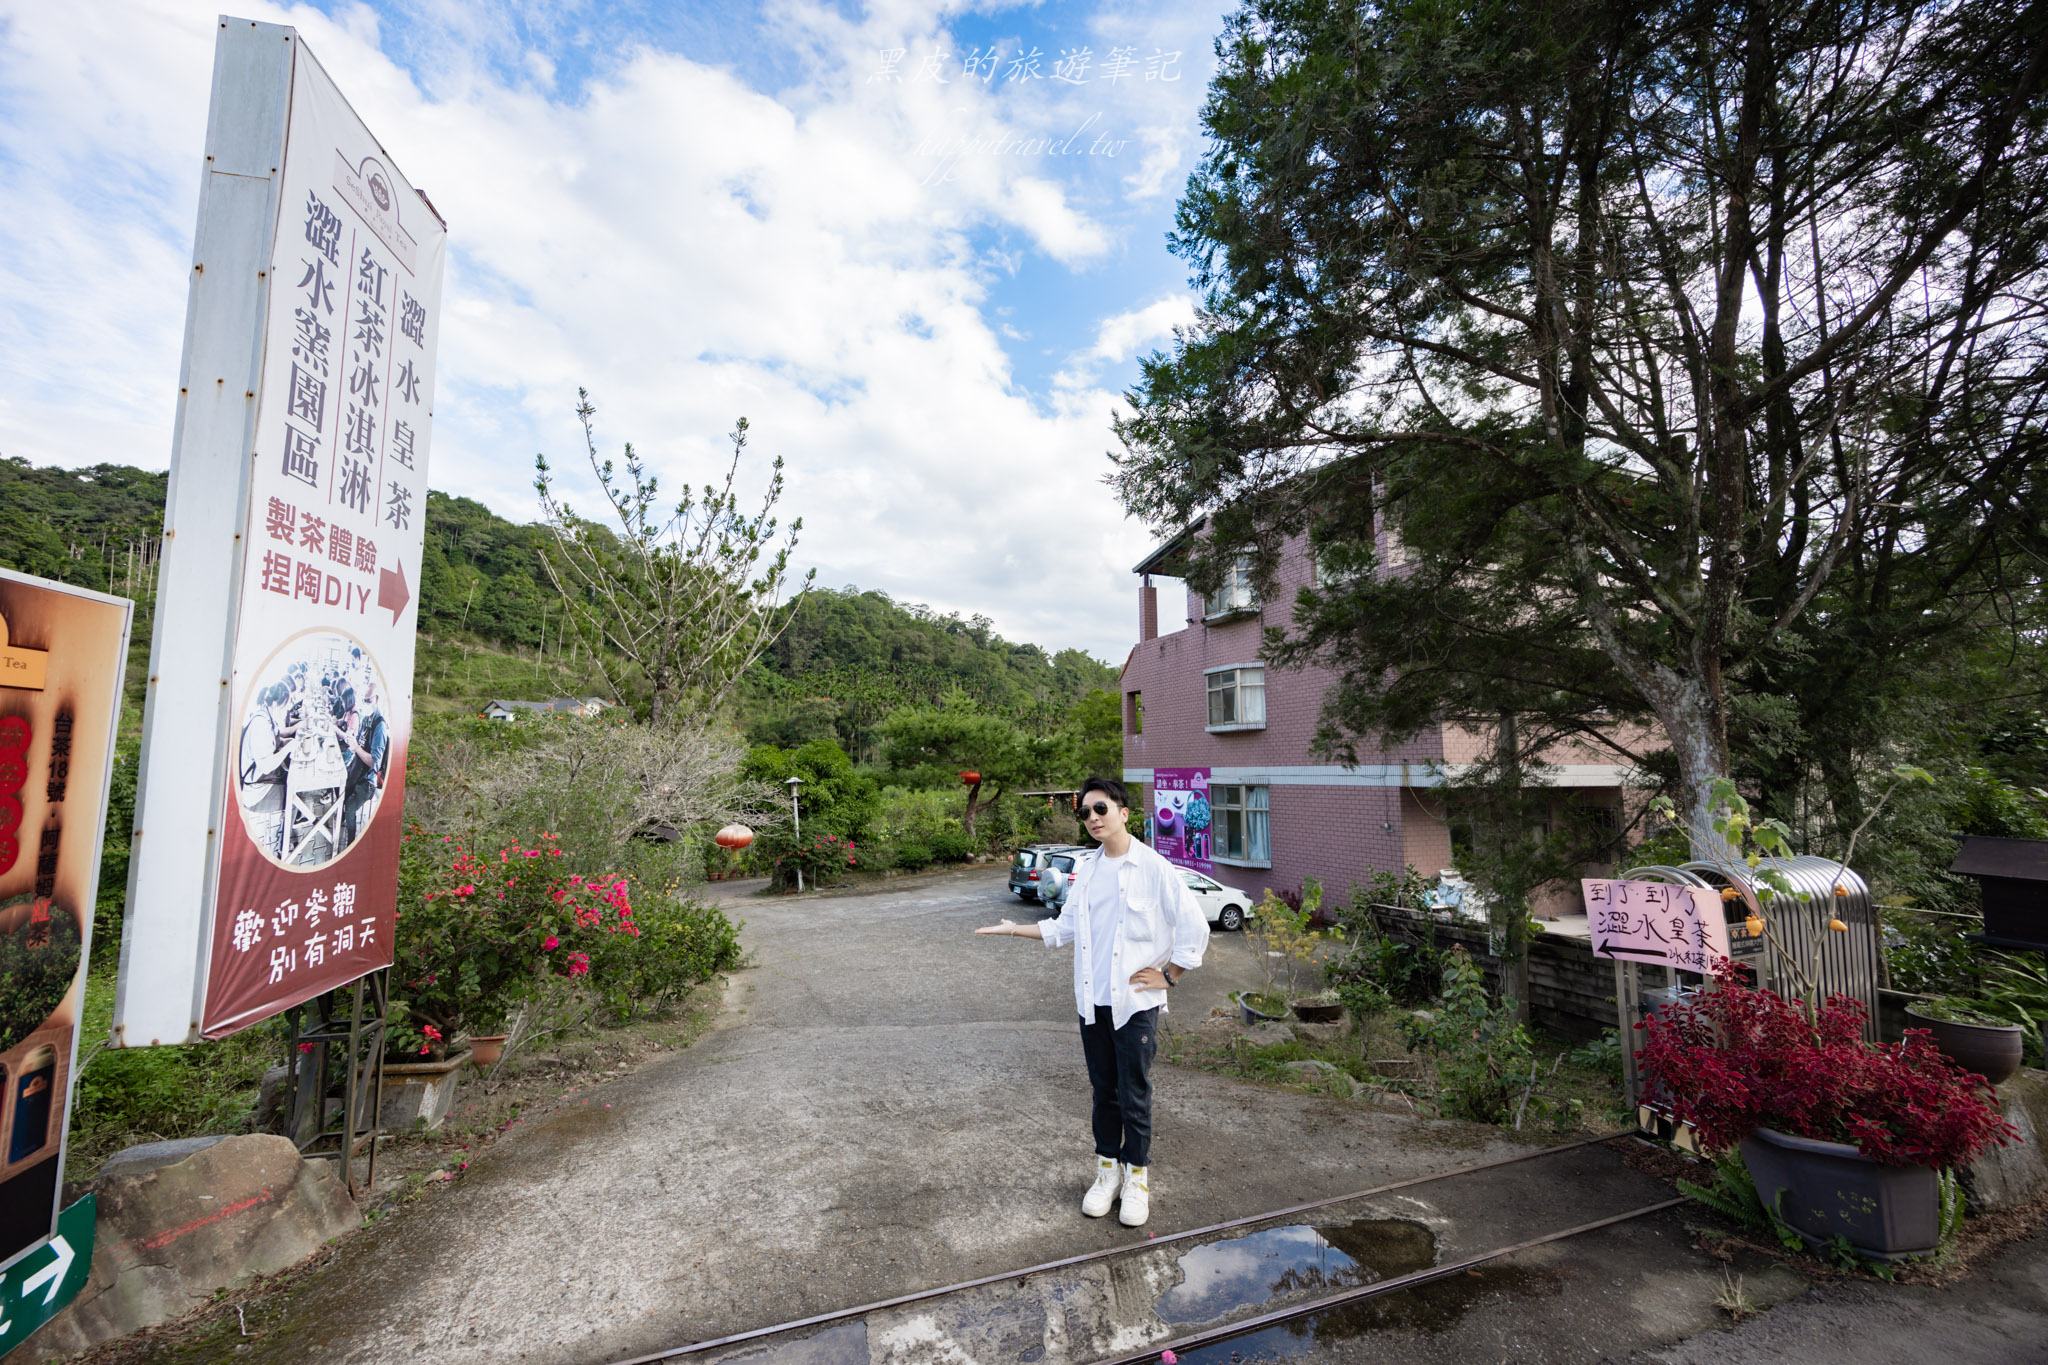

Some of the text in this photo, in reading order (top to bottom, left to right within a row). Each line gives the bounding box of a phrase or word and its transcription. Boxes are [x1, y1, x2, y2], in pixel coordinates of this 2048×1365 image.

[282, 188, 343, 489] 澀水窯園區
[339, 247, 388, 514] 紅茶冰淇淋
[385, 289, 427, 531] 澀水皇茶
[266, 496, 377, 575] 製茶體驗
[261, 549, 371, 615] 捏陶DIY
[2, 656, 27, 670] Tea
[232, 882, 356, 953] 歡迎參觀
[269, 917, 376, 985] 別有洞天
[1598, 911, 1719, 953] 澀水皇茶
